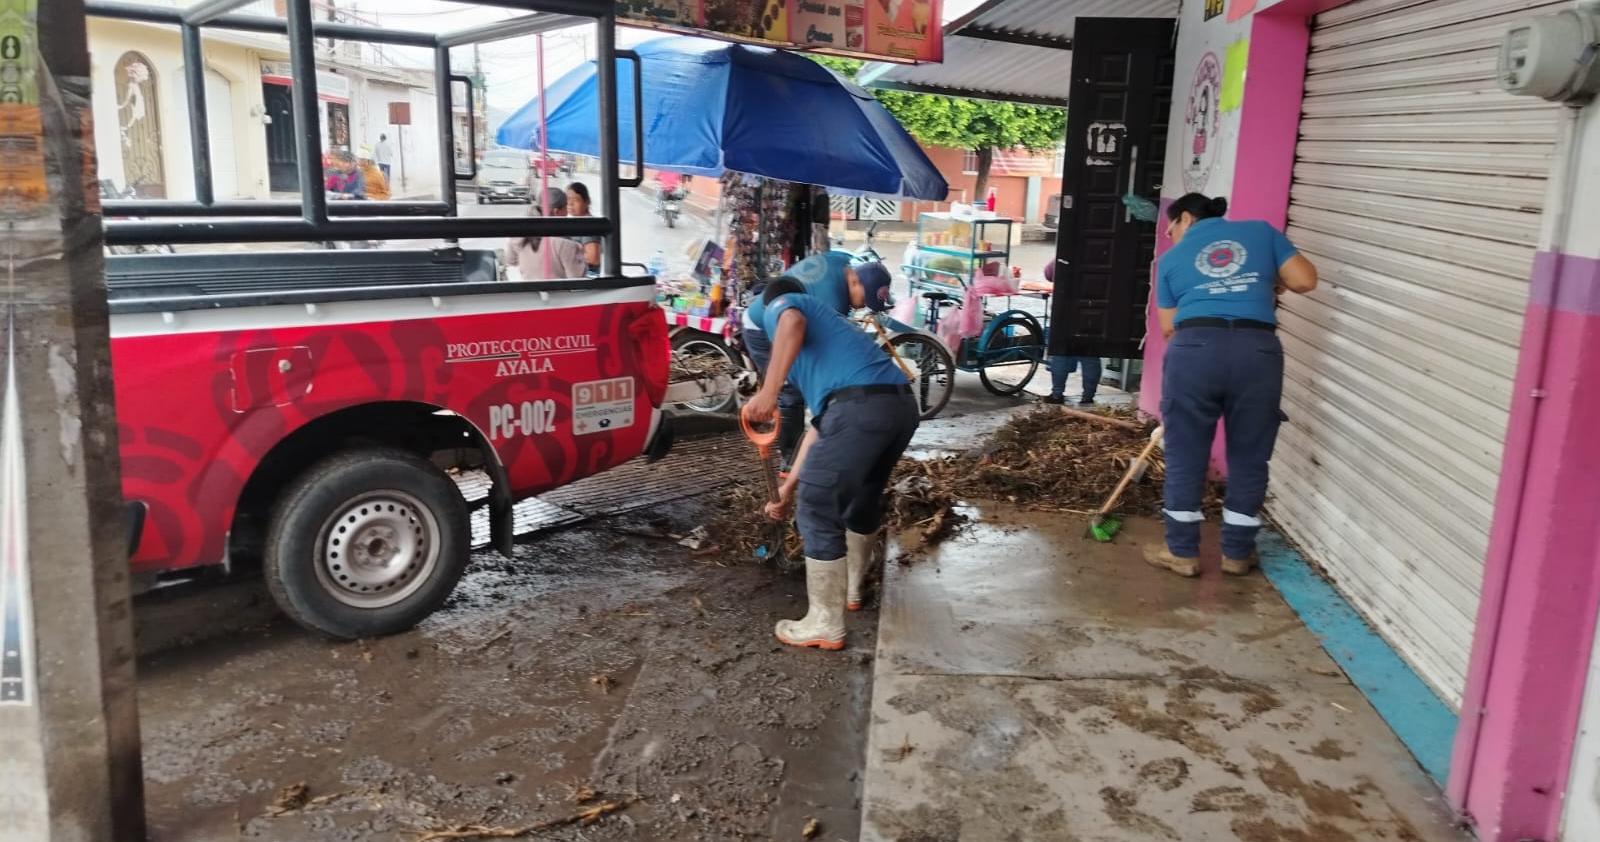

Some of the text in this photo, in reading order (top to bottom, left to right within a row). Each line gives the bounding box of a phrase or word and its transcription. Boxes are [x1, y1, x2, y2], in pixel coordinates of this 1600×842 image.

[446, 334, 595, 358] PROTECCION CIVIL
[495, 358, 554, 377] AYALA
[489, 398, 556, 440] PC-002
